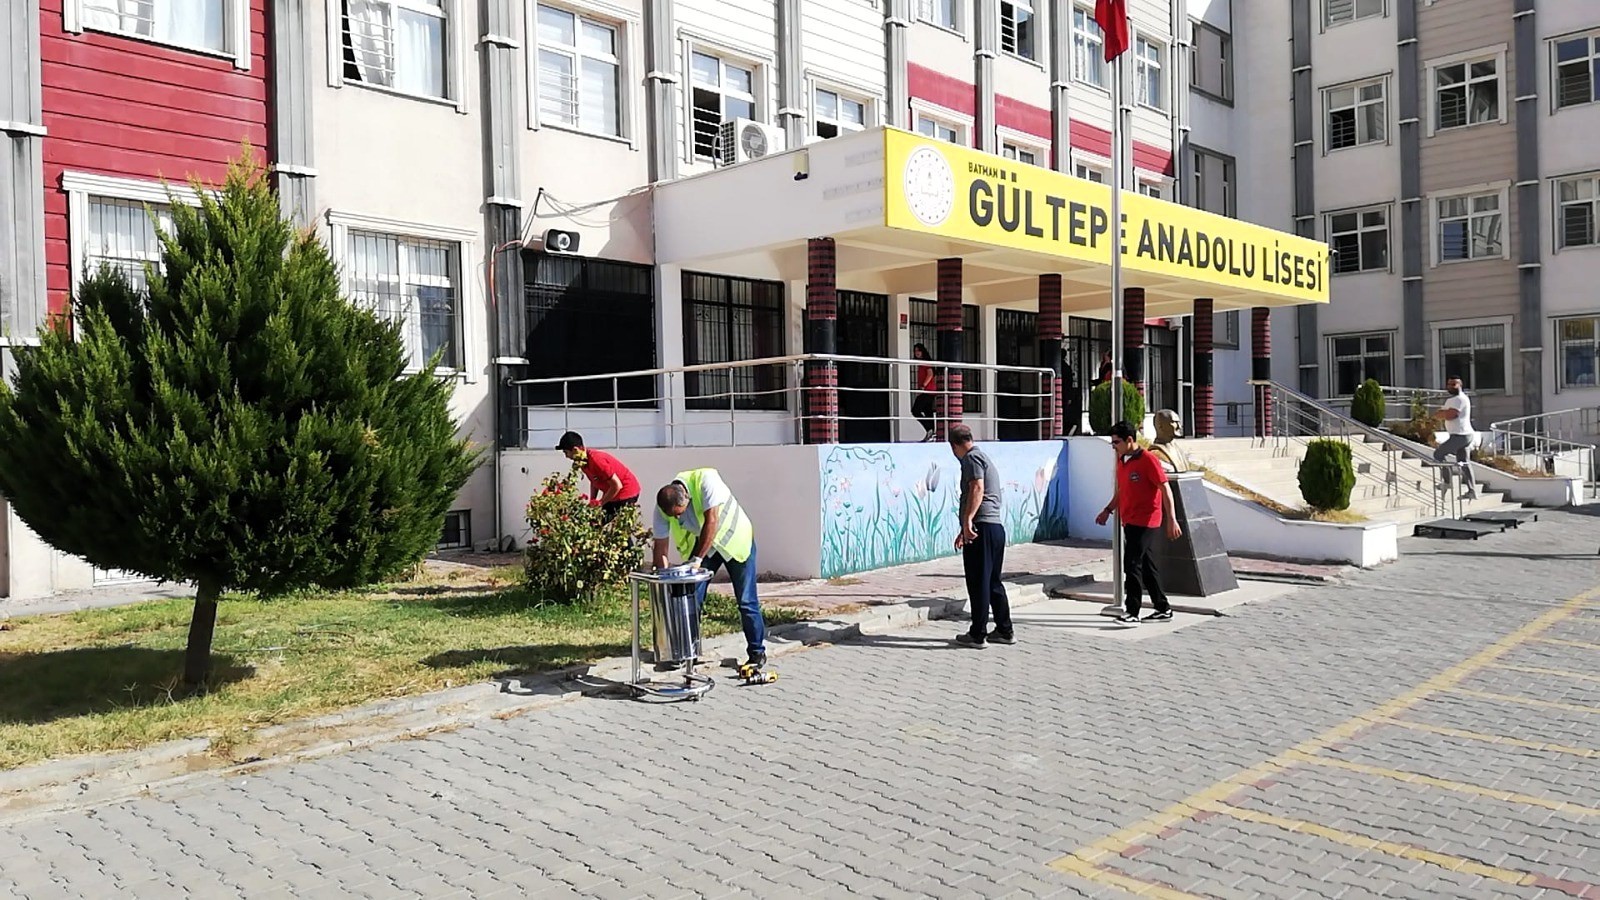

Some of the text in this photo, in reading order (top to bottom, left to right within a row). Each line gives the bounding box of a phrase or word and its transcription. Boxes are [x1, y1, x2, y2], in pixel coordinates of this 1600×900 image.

[968, 161, 998, 179] BATMAN
[1136, 218, 1255, 278] ANADOLU
[1263, 240, 1322, 292] LİSESİ
